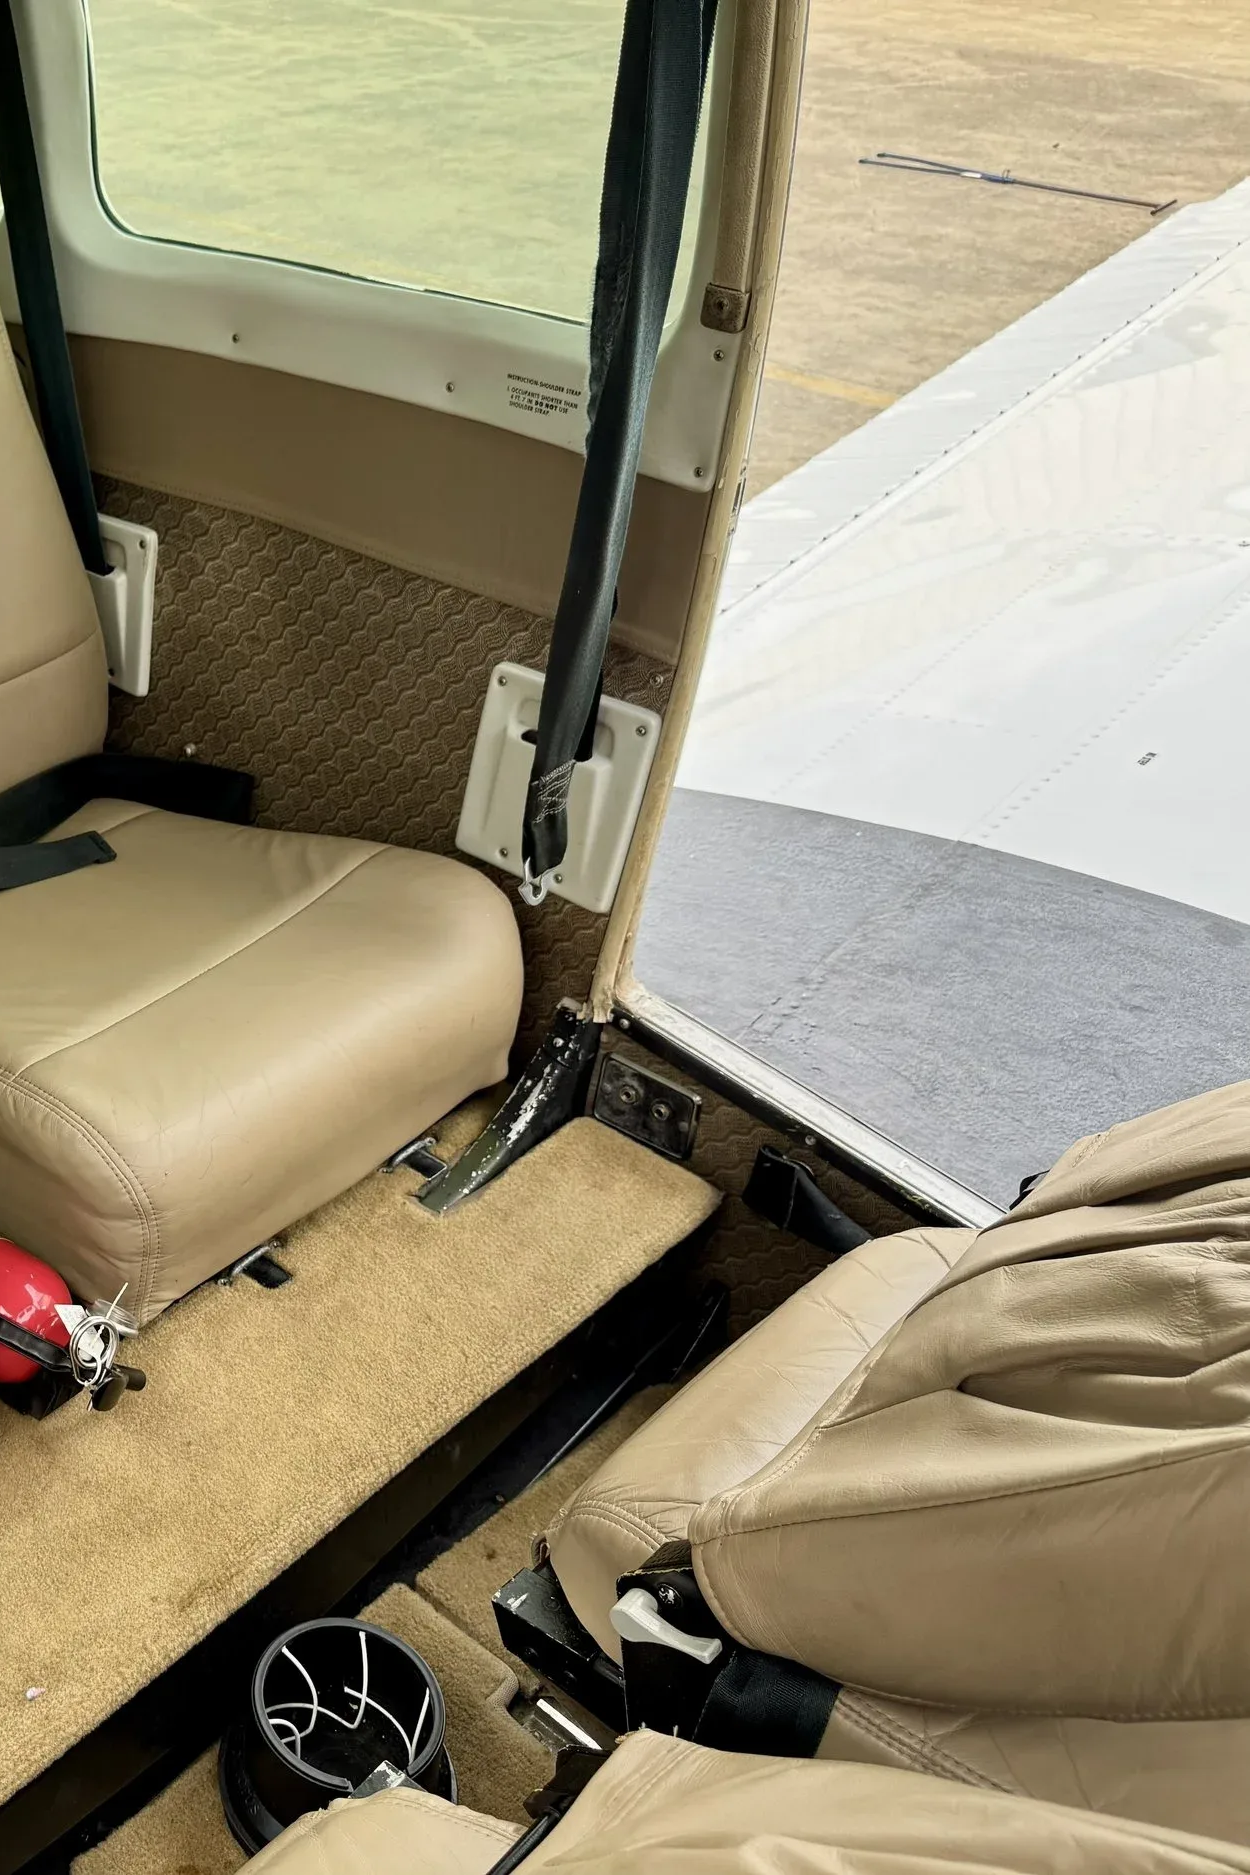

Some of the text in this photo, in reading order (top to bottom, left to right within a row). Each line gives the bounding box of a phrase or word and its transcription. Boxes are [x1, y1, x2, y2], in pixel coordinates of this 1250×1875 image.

[566, 388, 581, 396] STRAP
[511, 387, 540, 399] OCCUPANTS
[541, 395, 562, 405] SHORTER
[563, 400, 578, 409] THAN
[509, 401, 533, 411] SHOULDER
[545, 403, 558, 411] NOT
[558, 406, 568, 414] USE
